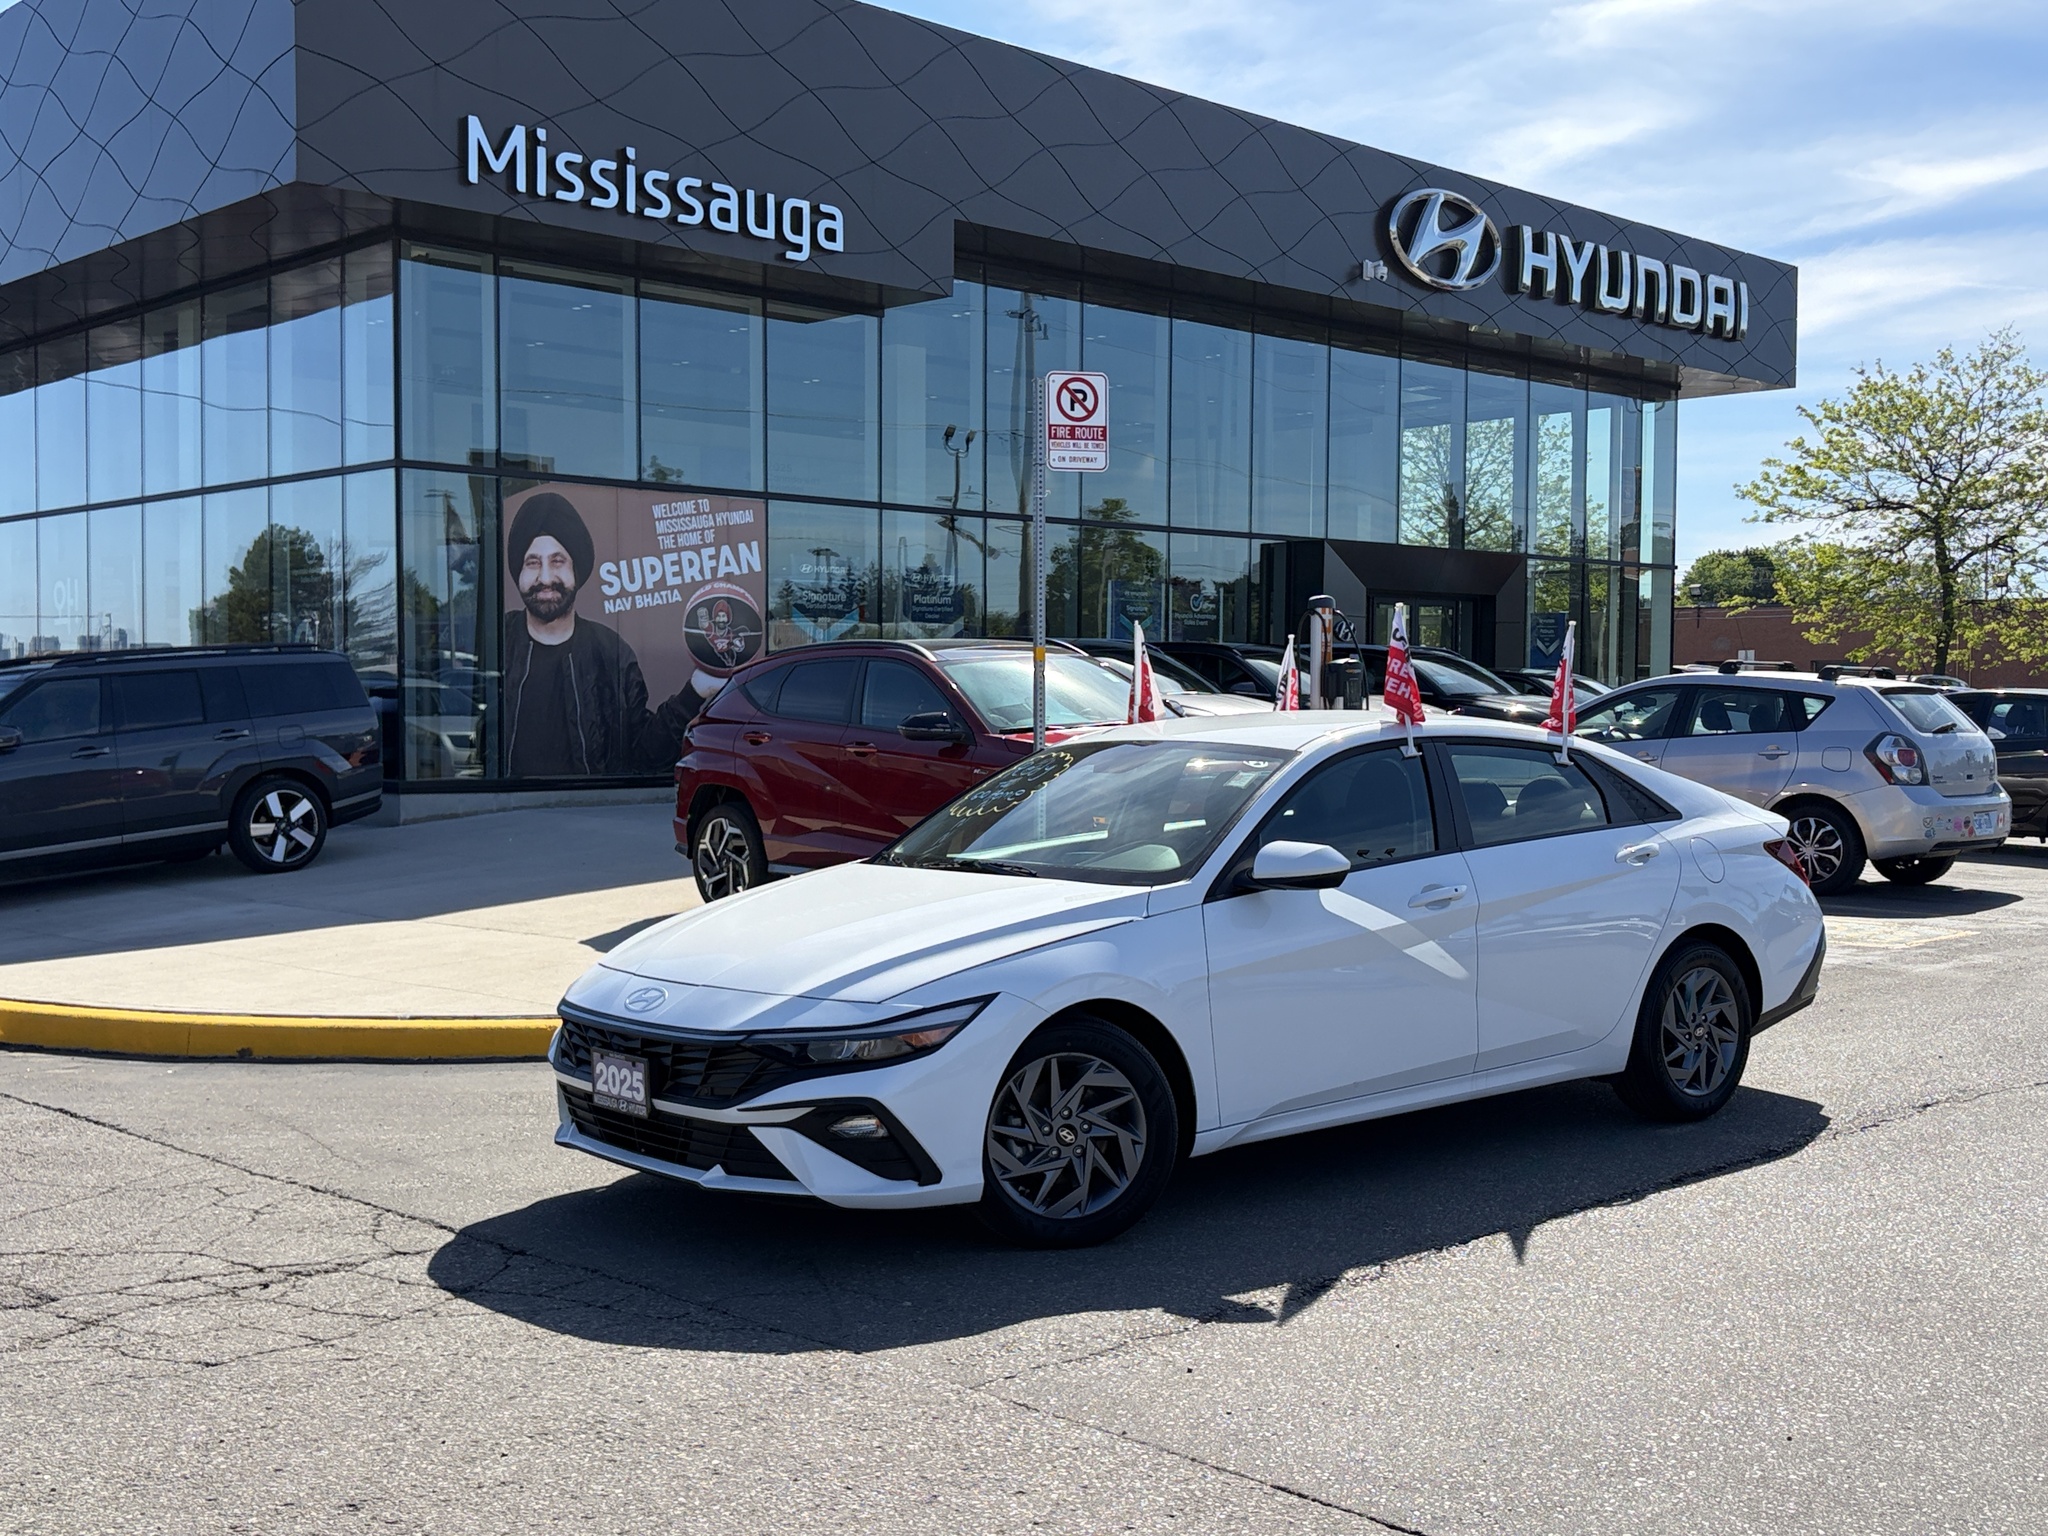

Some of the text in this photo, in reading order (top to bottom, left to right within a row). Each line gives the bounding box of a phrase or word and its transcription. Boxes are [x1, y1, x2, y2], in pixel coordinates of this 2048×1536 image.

[466, 113, 845, 262] Mississauga
[1517, 224, 1749, 341] HYUNDAI
[1051, 426, 1104, 439] FIRE ROUTE
[652, 498, 710, 519] WELCOME TO
[655, 509, 755, 535] MISSISSAUGA HYUNDAI
[657, 529, 715, 550] THE HOME OF
[599, 540, 762, 597] SUPERFAN
[604, 596, 632, 615] NAV
[635, 588, 682, 610] BHATIA
[802, 590, 847, 603] Signature
[913, 594, 951, 605] Platinum
[595, 1061, 645, 1102] 2025
